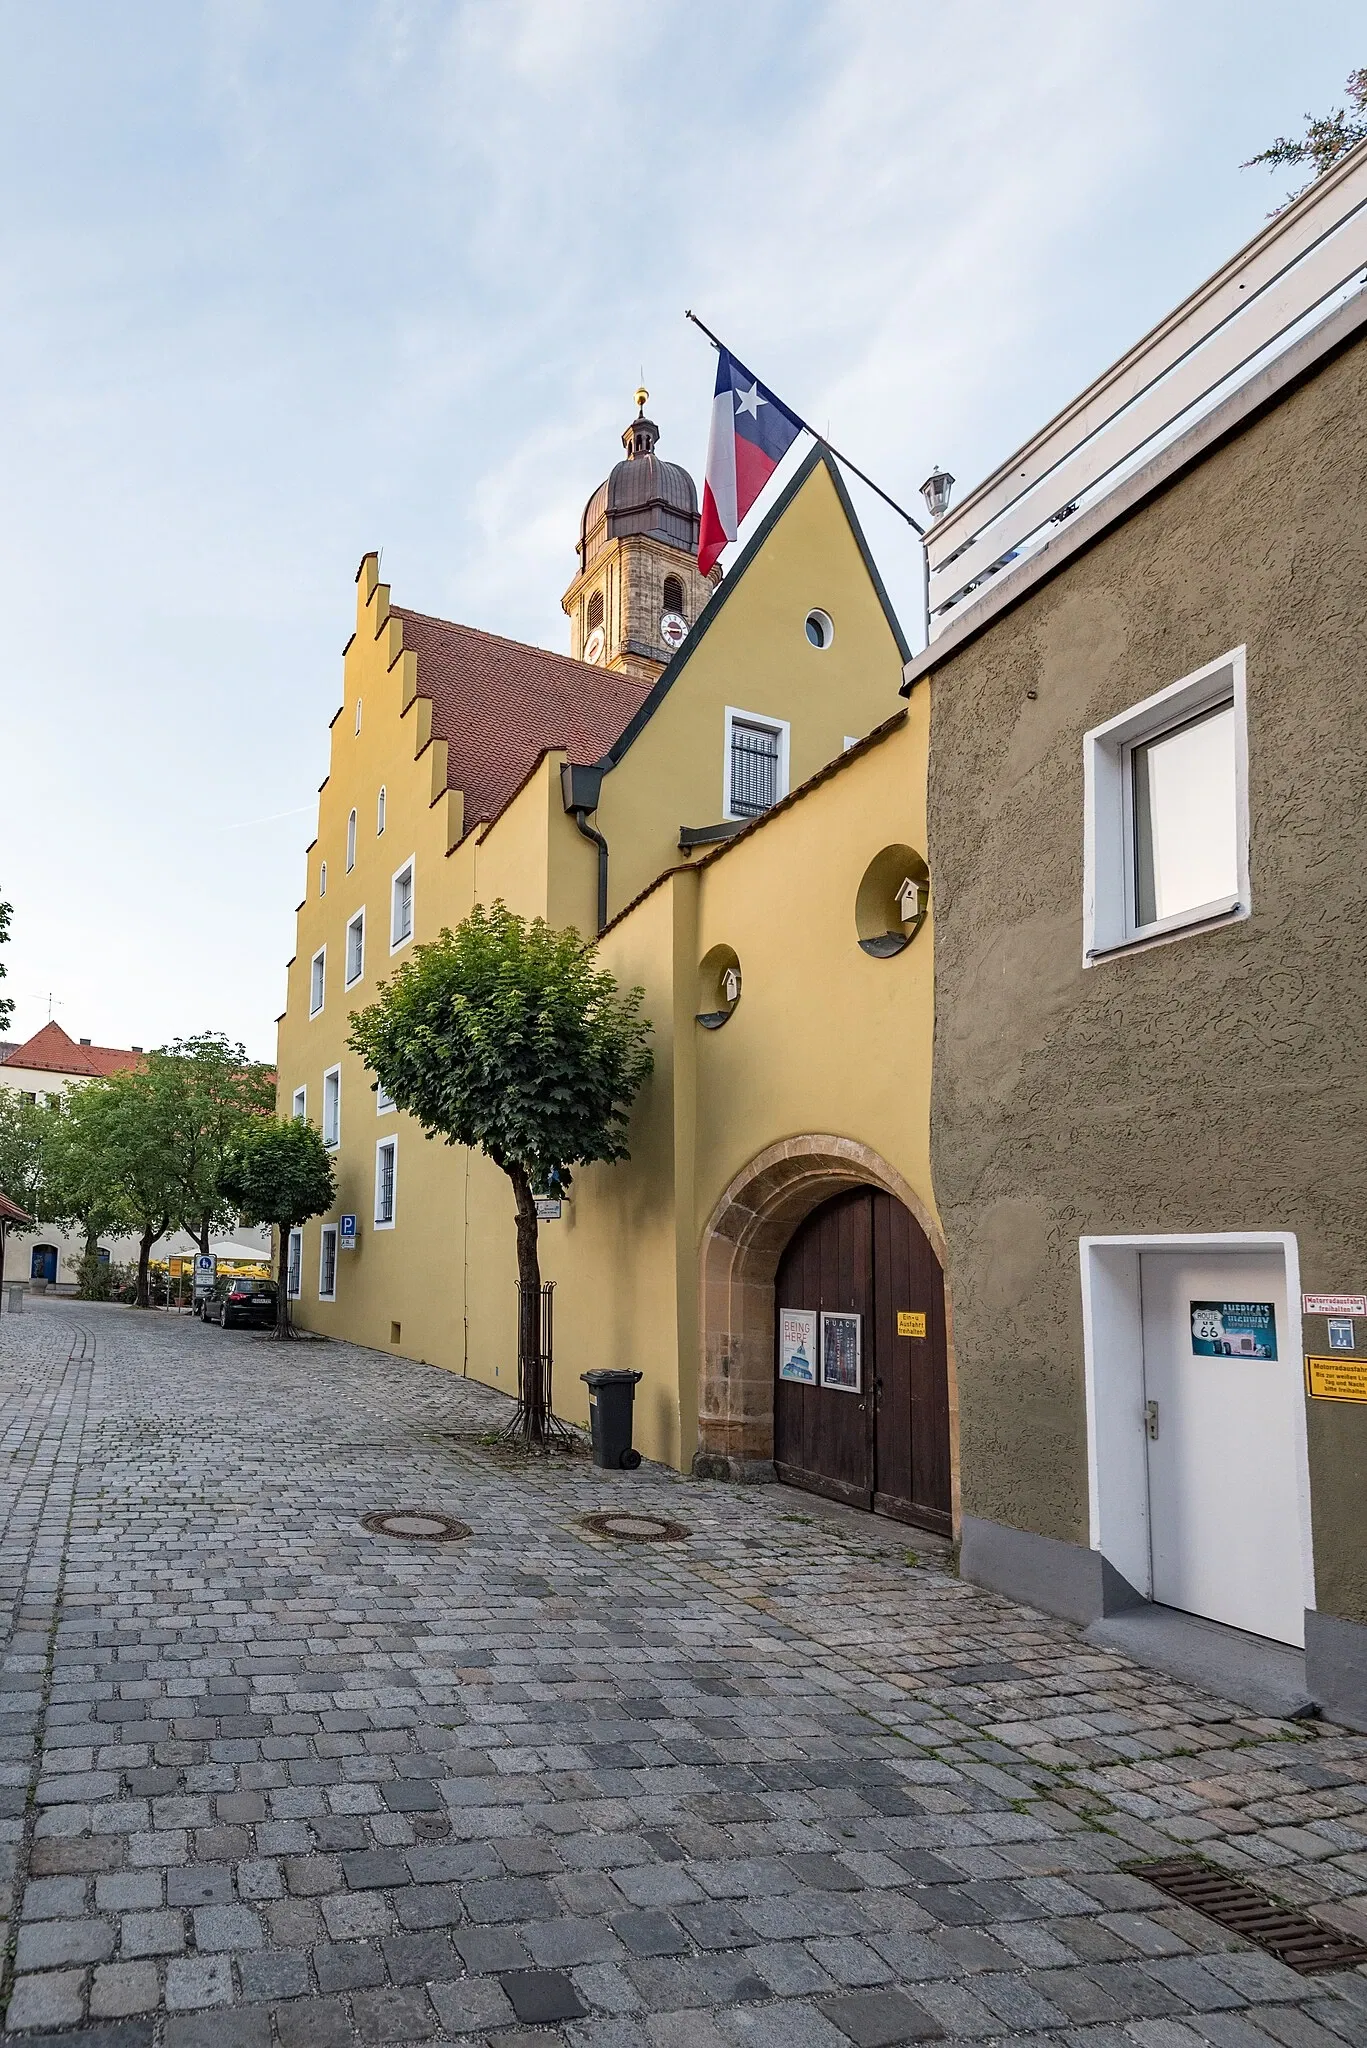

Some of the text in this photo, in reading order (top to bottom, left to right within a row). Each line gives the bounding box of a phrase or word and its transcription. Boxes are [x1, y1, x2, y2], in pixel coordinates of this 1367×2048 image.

[1197, 1312, 1218, 1320] ROUTE
[1223, 1304, 1270, 1317] AMERICA'S
[784, 1321, 810, 1333] BEING
[825, 1319, 856, 1328] RUACH
[899, 1320, 924, 1328] Ausfahrt
[1227, 1315, 1270, 1328] HIGHWAY
[784, 1331, 807, 1344] HERE
[1200, 1326, 1218, 1338] 66
